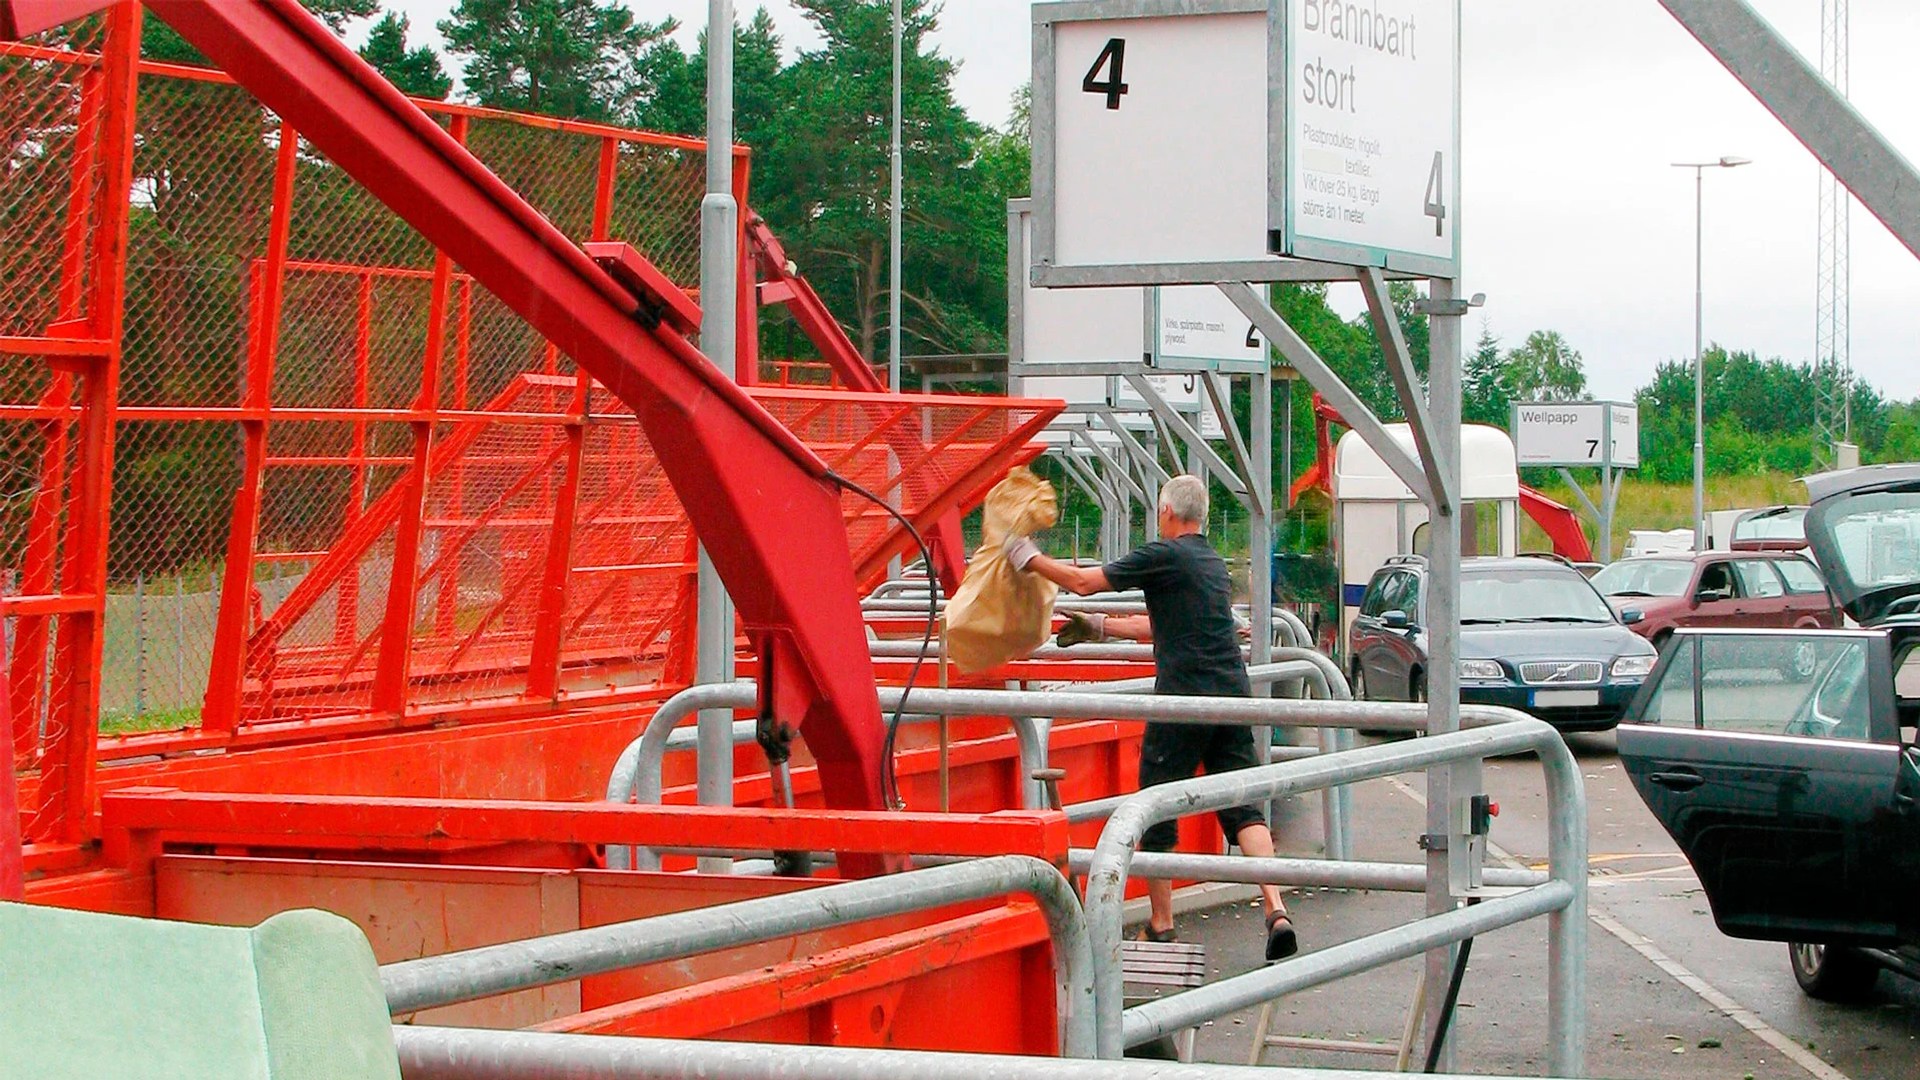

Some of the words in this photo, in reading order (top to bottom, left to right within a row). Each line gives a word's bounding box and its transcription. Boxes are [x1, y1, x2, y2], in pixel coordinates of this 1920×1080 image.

[1083, 38, 1128, 110] 4
[1303, 56, 1355, 113] stort
[1336, 179, 1346, 197] 25
[1423, 150, 1446, 237] 4
[1522, 411, 1578, 424] Wellpapp
[1586, 440, 1599, 458] 7
